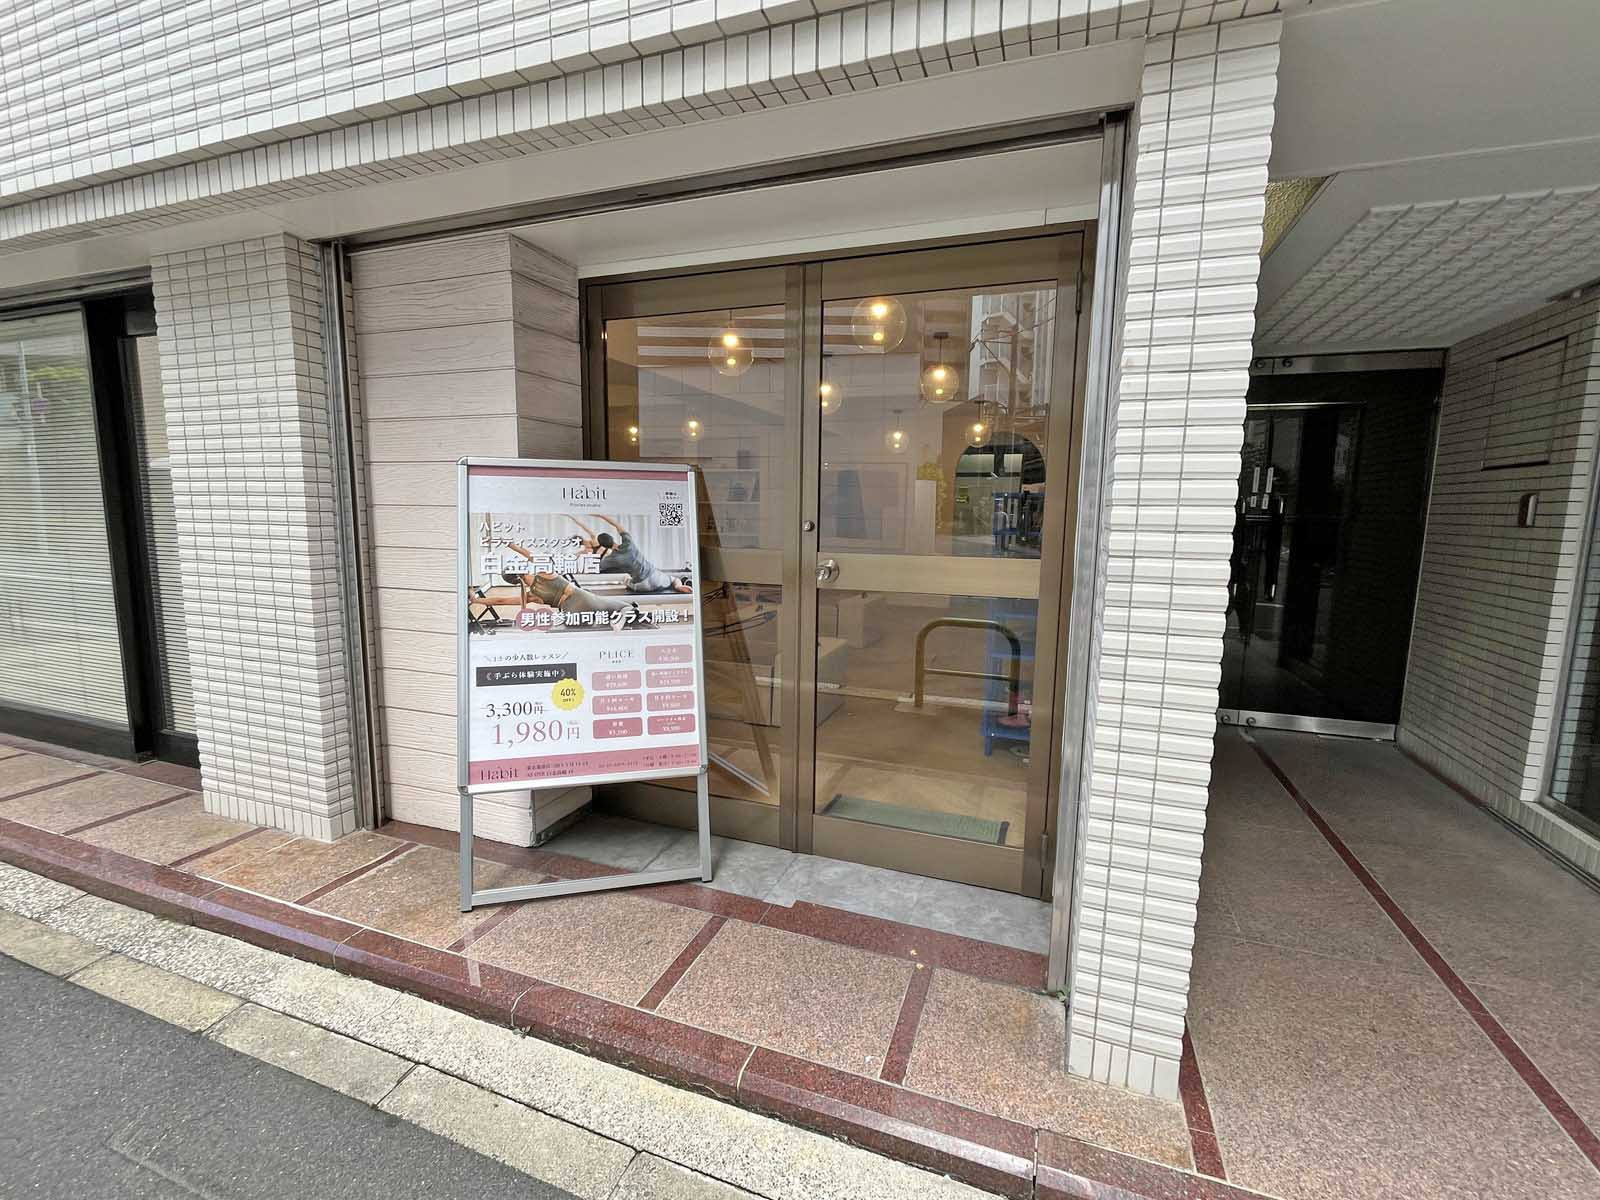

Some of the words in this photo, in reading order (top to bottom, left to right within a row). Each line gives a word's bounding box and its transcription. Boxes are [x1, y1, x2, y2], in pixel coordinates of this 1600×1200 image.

[562, 485, 607, 500] Habit
[480, 521, 526, 534] ハビット
[480, 536, 582, 549] ピラティススタジオ
[480, 552, 601, 575] 白金高輪店
[521, 609, 689, 627] 男性参加可能クラス開設！
[560, 688, 577, 697] 40%
[486, 701, 544, 720] 3,300円
[492, 719, 580, 749] 1,980円
[480, 767, 519, 782] Habit
